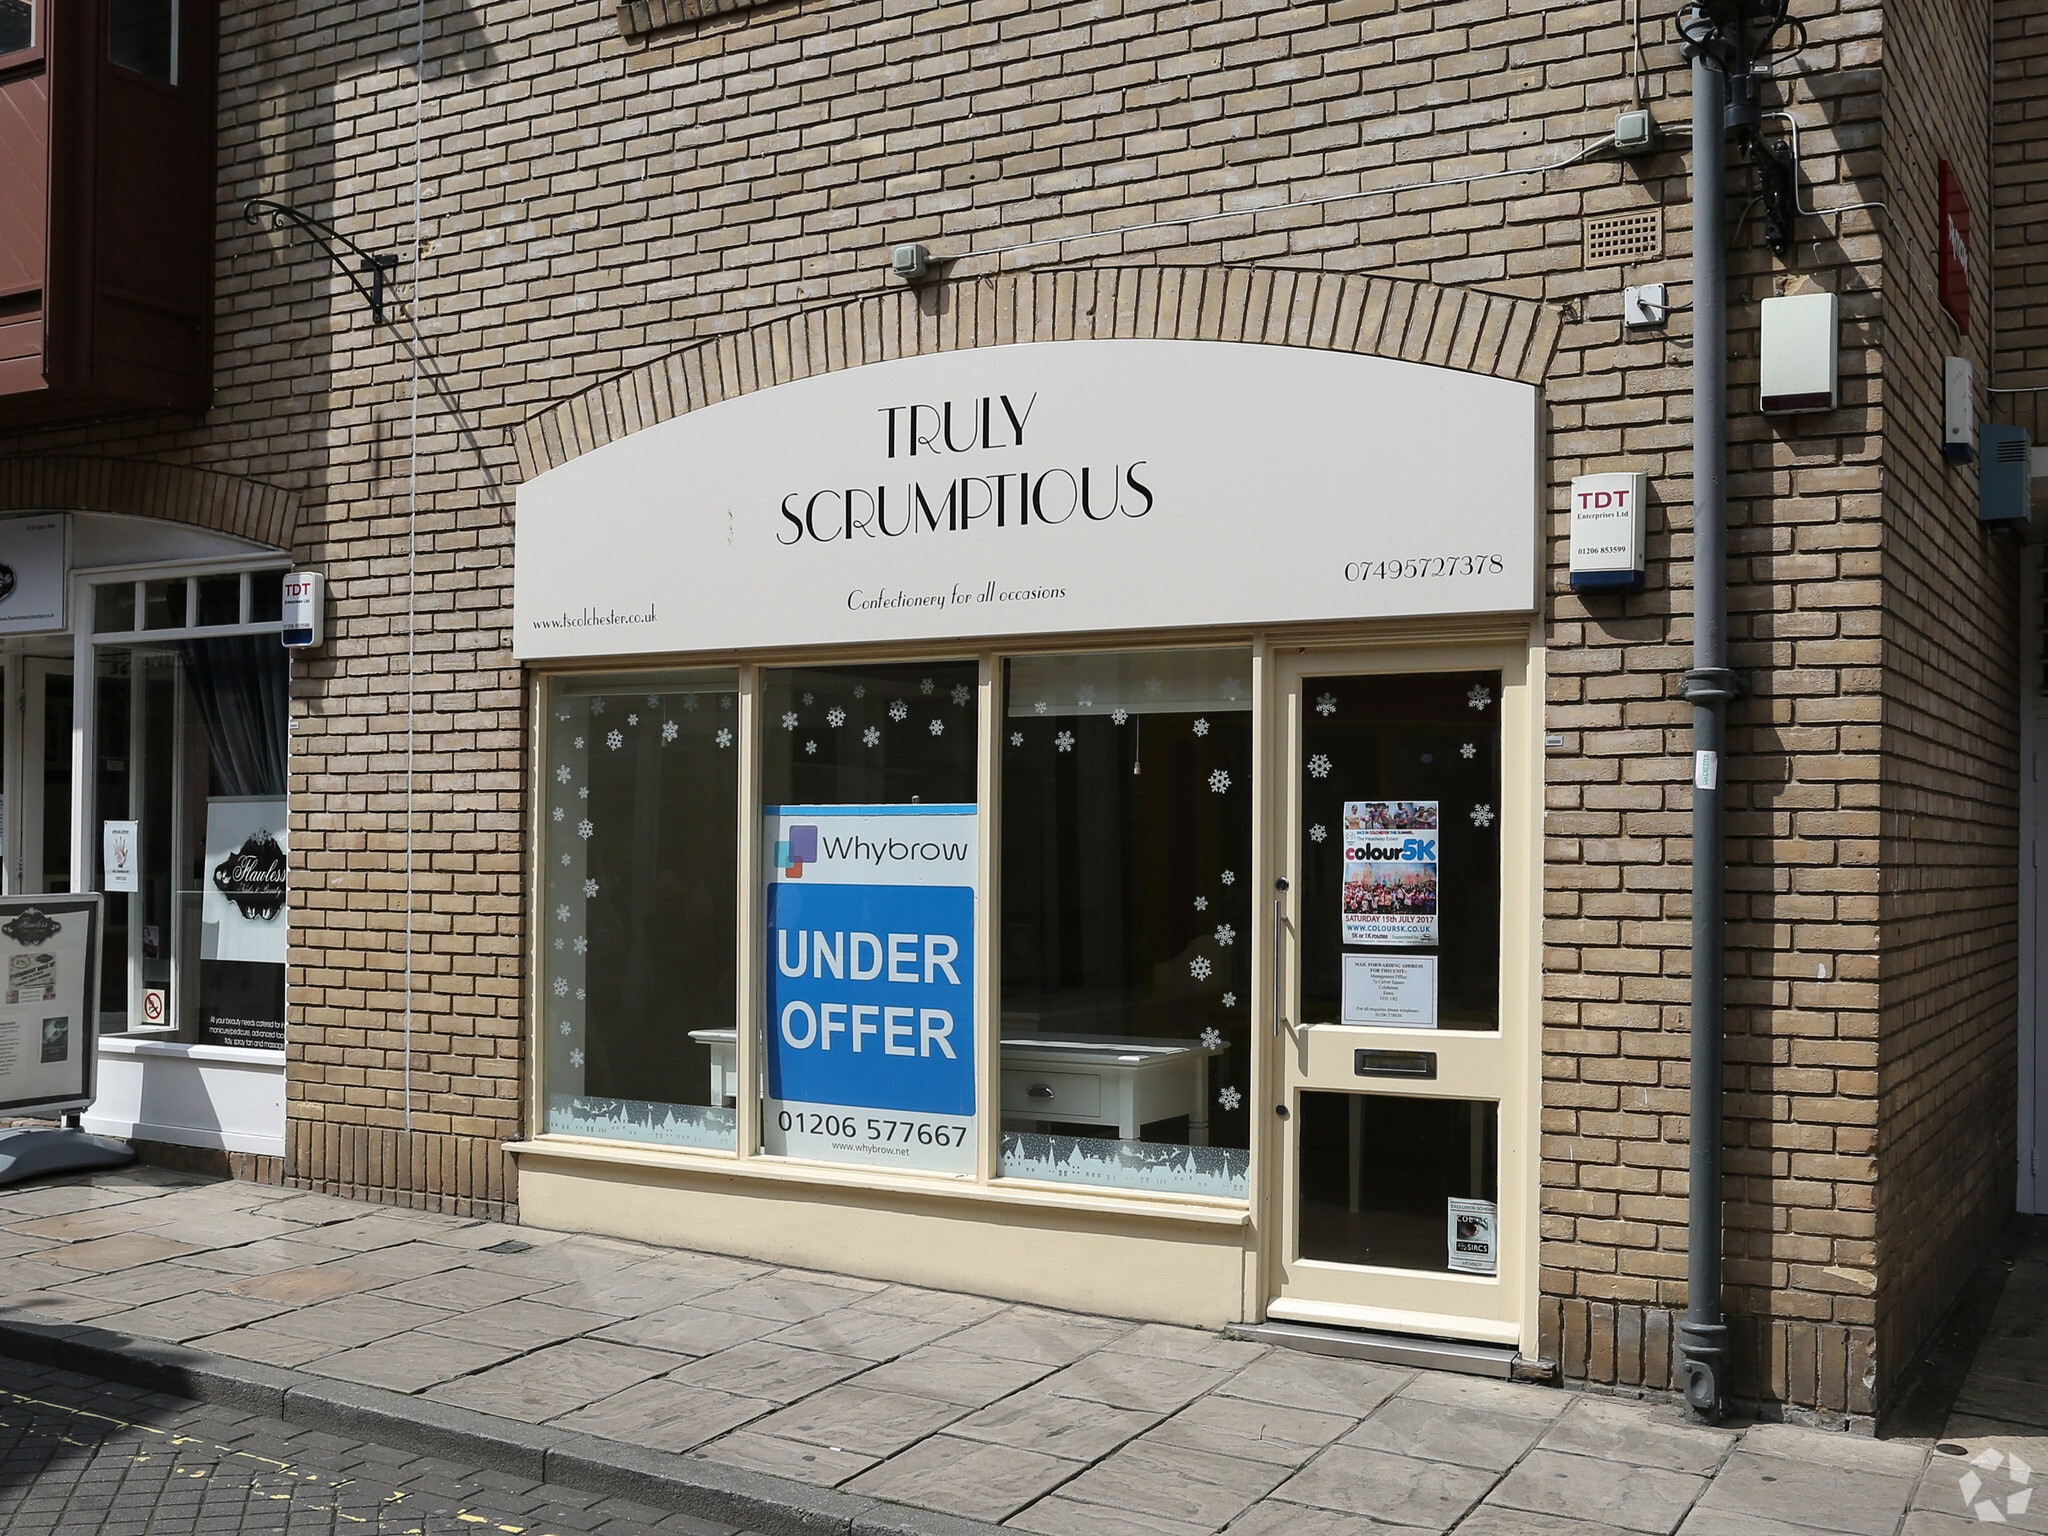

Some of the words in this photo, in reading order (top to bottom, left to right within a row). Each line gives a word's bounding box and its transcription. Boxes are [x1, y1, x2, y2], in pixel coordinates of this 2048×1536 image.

[878, 390, 1038, 460] TRULY
[776, 460, 1156, 546] SCRUMPTIOUS
[1577, 490, 1630, 510] TDT
[1577, 512, 1615, 521] Enterprises
[1616, 510, 1629, 518] Ltd
[1578, 547, 1599, 555] 01206
[1600, 545, 1626, 554] 853599
[1343, 553, 1506, 583] 07495727378
[285, 583, 311, 597] TDT
[846, 586, 947, 614] Confectionery
[950, 583, 973, 610] for
[976, 581, 997, 607] all
[999, 585, 1069, 604] occasions
[532, 603, 657, 630] www.tscolchester.co.uk
[822, 836, 968, 866] Whybrow
[1345, 839, 1436, 862] colour5K
[232, 855, 286, 882] Flawless
[1345, 915, 1381, 923] SATURDAY
[1398, 916, 1416, 924] JULY
[777, 929, 961, 986] UNDER
[225, 1017, 241, 1026] beauty
[780, 1000, 957, 1060] OFFER
[778, 1110, 857, 1139] 01206
[867, 1118, 967, 1148] 577667
[831, 1140, 910, 1157] www.whybrow.net
[1467, 1243, 1488, 1252] SIRCS
